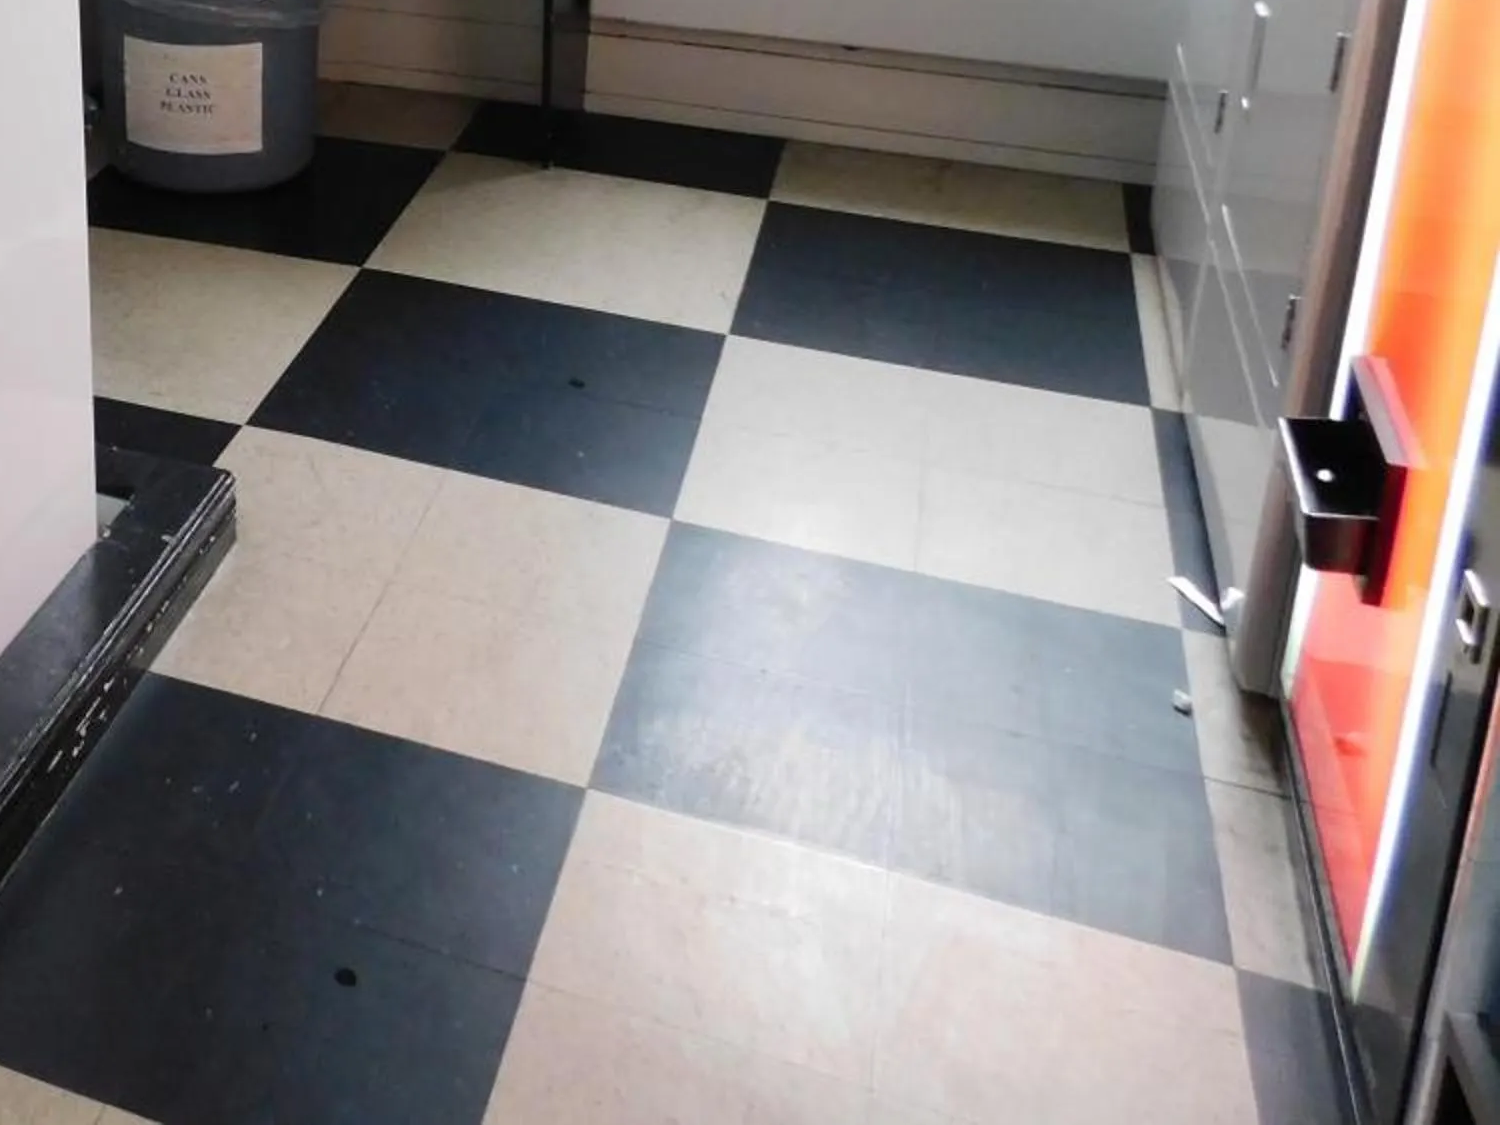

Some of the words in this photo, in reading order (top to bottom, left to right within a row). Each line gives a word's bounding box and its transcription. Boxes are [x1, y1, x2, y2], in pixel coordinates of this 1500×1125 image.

[169, 73, 207, 84] CANS
[165, 88, 212, 100] GLASS
[160, 101, 216, 114] PLASTIC
